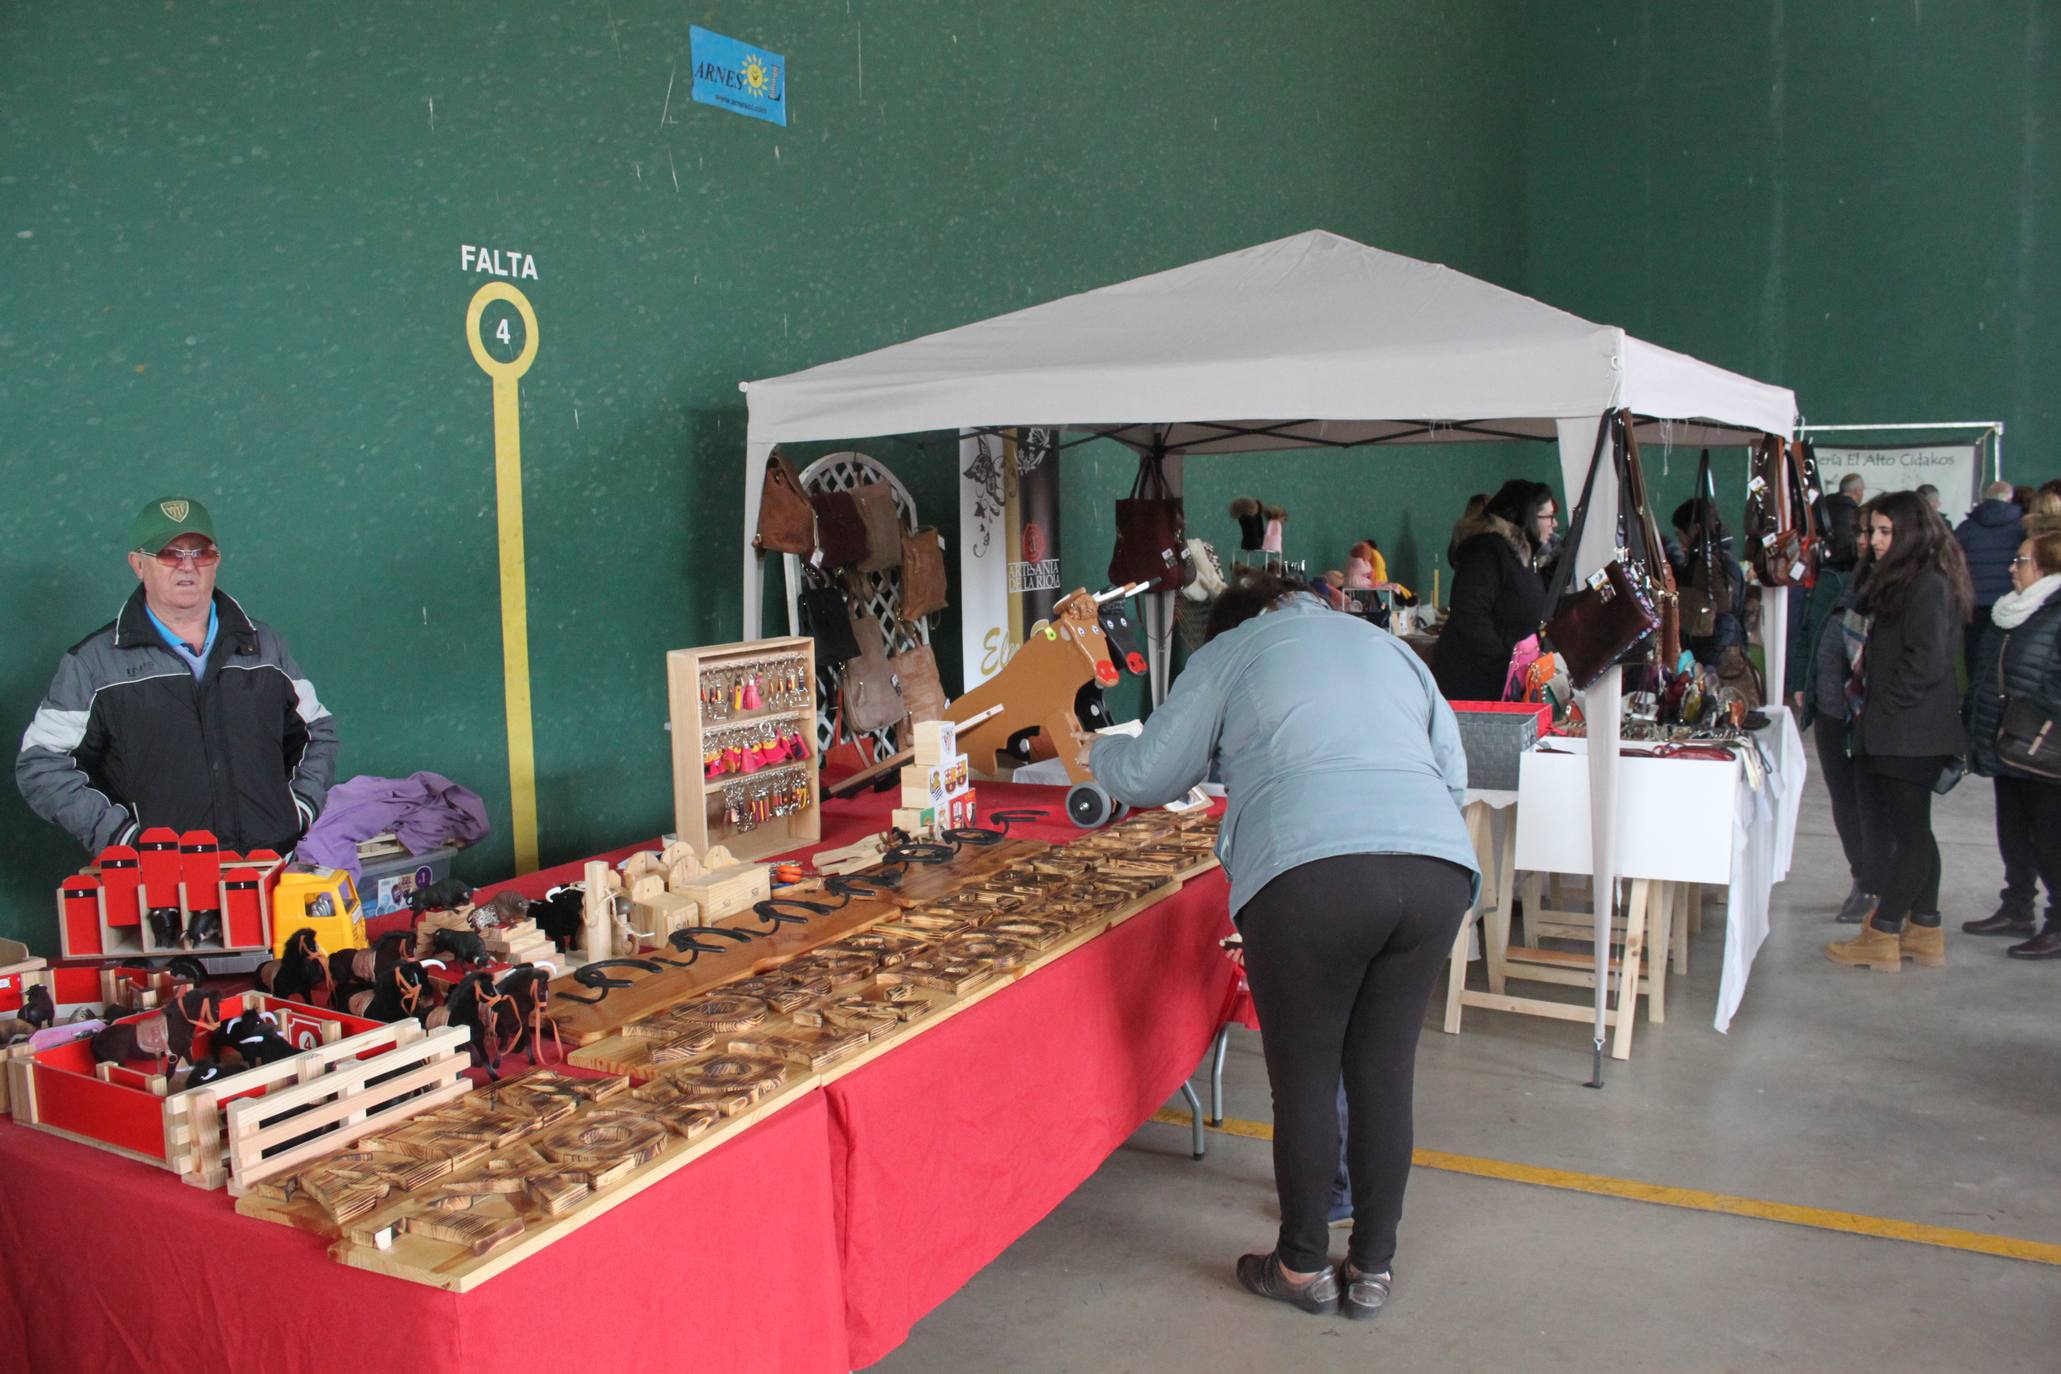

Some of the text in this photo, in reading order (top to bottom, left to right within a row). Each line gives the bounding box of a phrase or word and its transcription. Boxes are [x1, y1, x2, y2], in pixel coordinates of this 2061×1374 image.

[461, 244, 539, 281] FALTA
[496, 318, 511, 344] 4
[1816, 452, 1955, 466] ería El Alto Cidakos
[1008, 574, 1061, 591] DE LA RIOJA
[304, 1036, 313, 1051] 4
